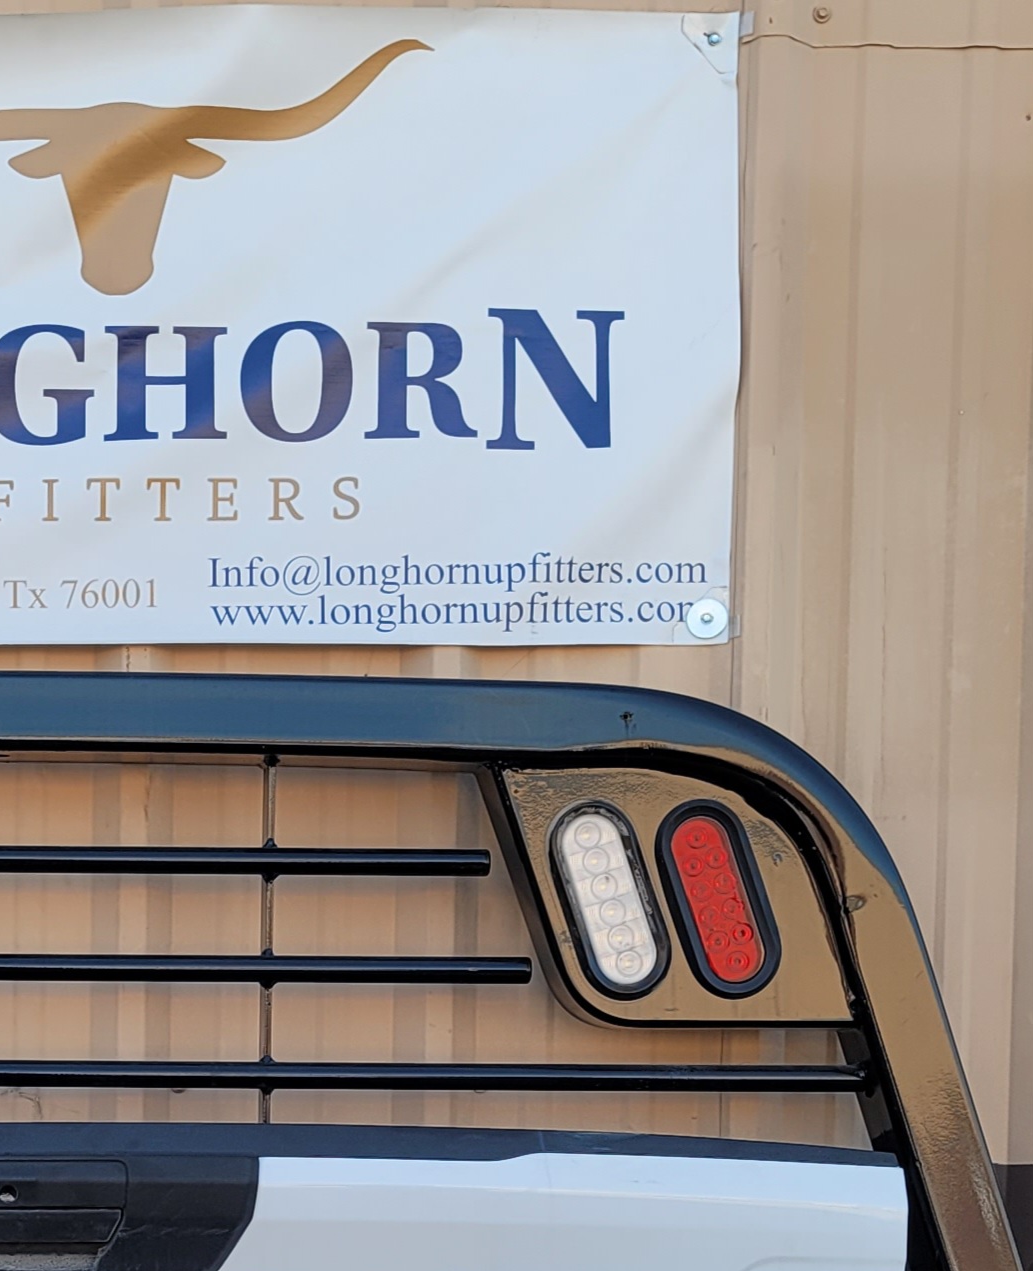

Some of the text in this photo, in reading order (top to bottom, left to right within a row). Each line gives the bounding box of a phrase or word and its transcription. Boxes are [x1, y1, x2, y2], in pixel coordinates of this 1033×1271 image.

[207, 552, 707, 592] Info@longhornupfitters.com
[3, 579, 48, 609] Tx
[60, 578, 158, 609] 76001
